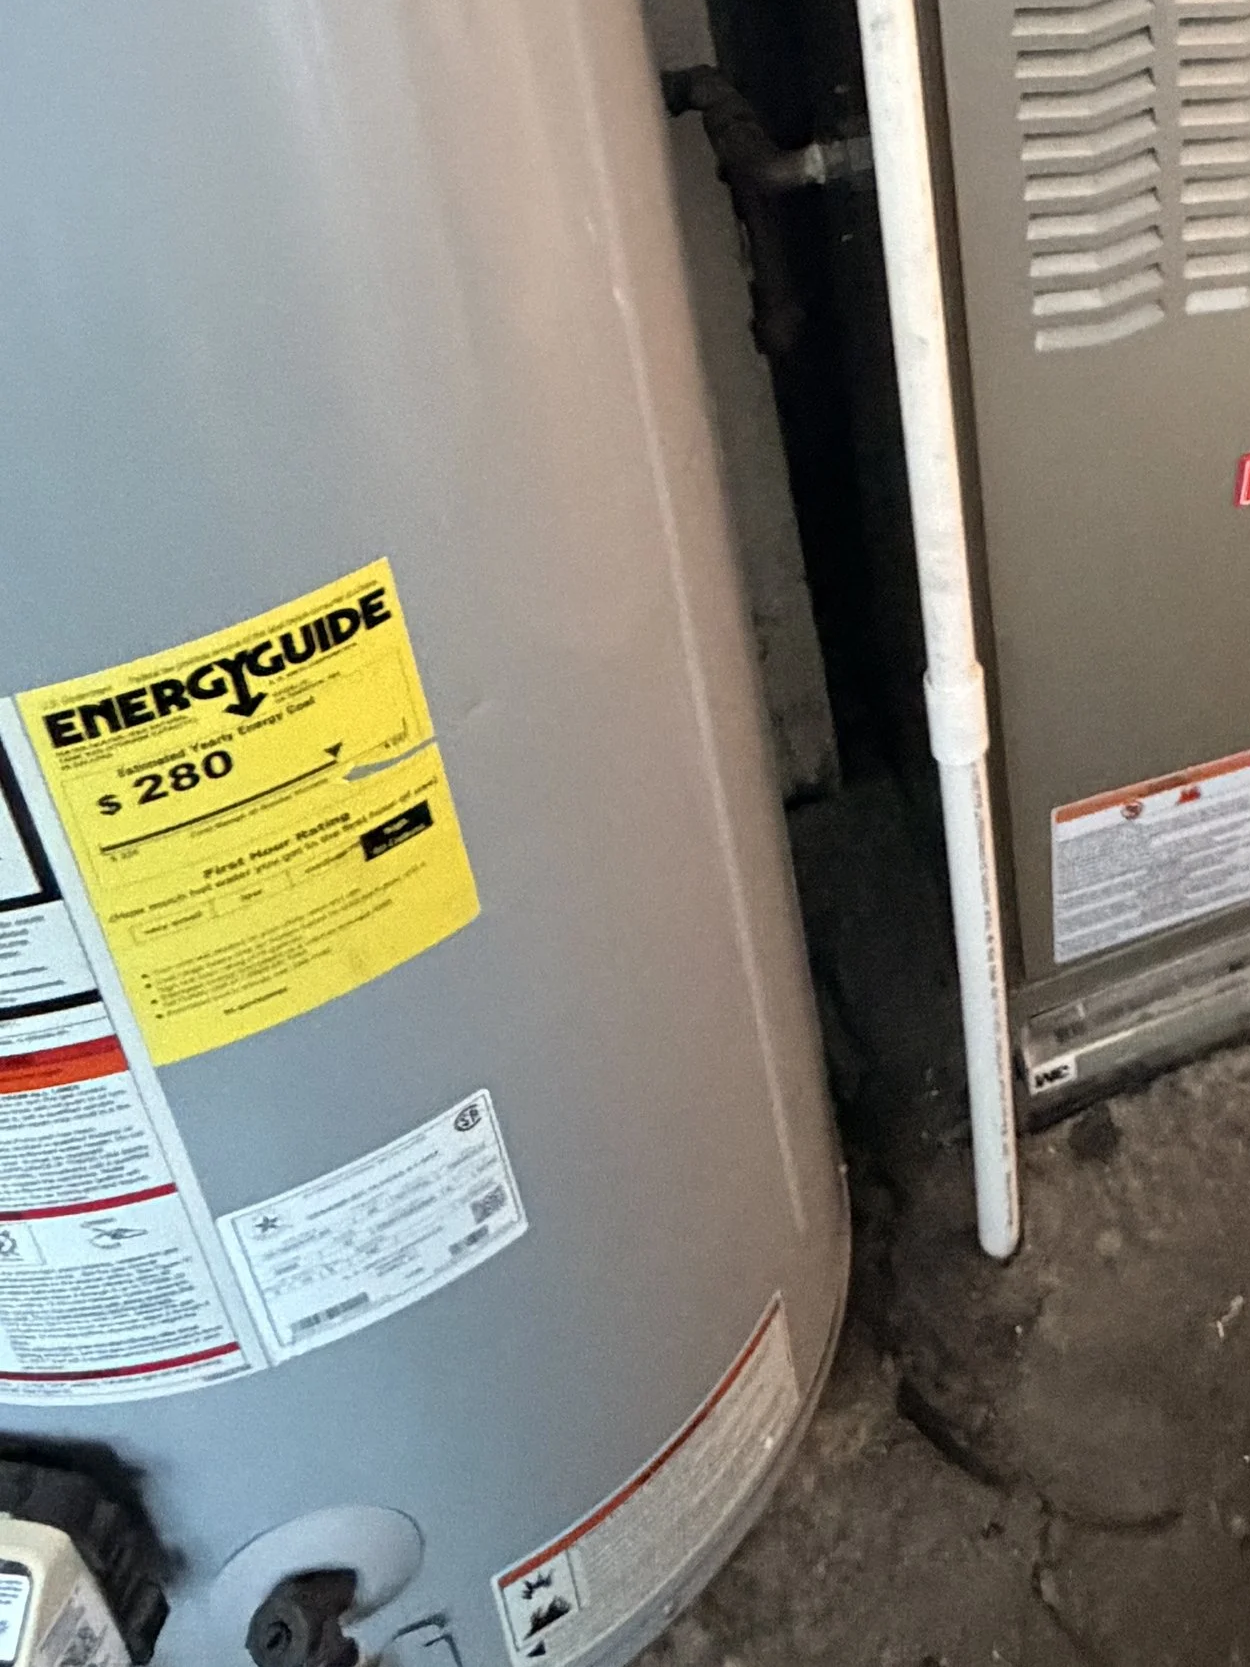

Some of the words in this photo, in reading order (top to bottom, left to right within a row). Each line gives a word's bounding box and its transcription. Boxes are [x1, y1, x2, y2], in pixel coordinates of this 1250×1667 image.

[42, 587, 392, 748] ENERGYGUIDE
[190, 731, 233, 753] Yearly
[95, 793, 122, 816] $
[133, 750, 233, 802] 280
[203, 857, 244, 878] First
[249, 838, 291, 859] Hour
[296, 813, 350, 839] Rating
